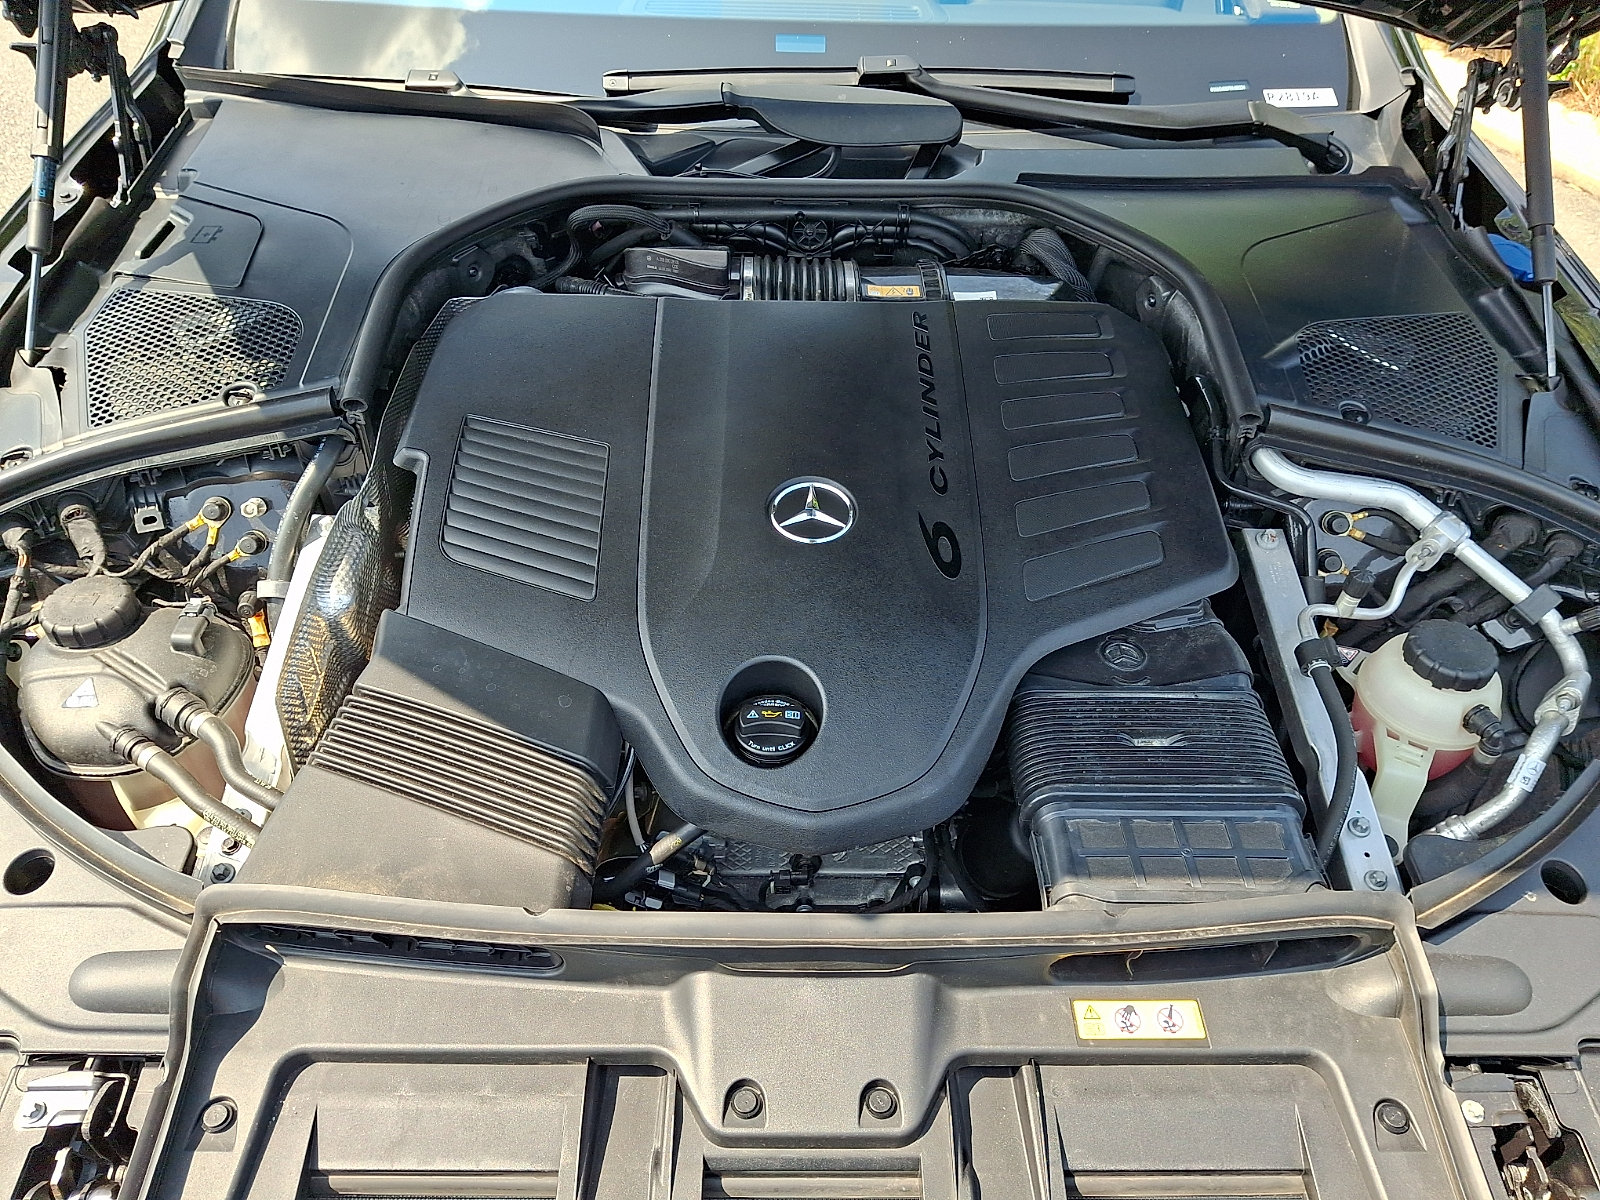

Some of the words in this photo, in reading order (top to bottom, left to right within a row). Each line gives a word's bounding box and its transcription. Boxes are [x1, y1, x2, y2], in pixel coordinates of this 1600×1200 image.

[912, 311, 948, 497] CYLINDER
[918, 511, 962, 580] 6
[748, 740, 761, 750] Turn
[777, 741, 796, 751] CLICK
